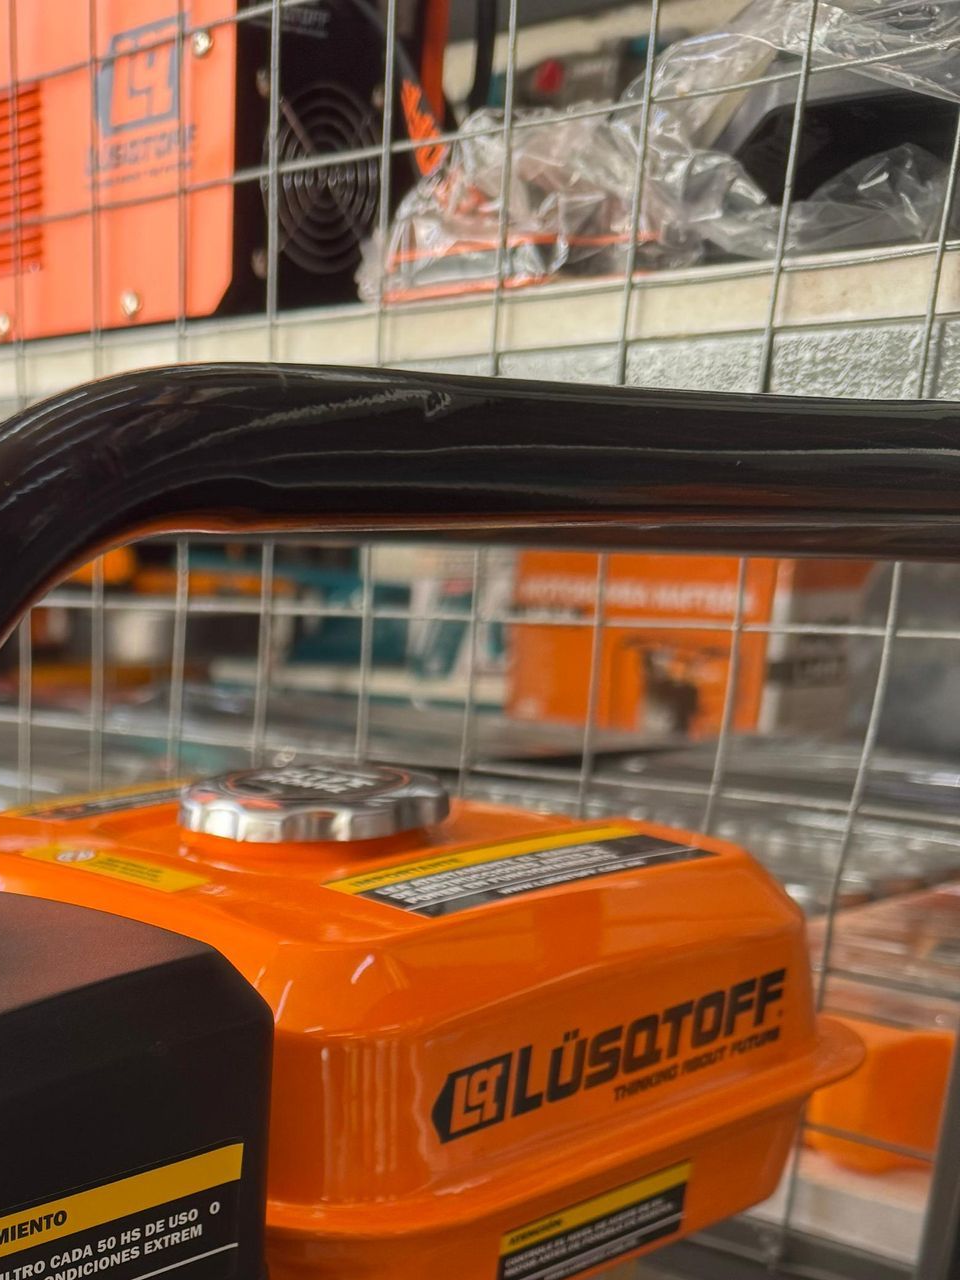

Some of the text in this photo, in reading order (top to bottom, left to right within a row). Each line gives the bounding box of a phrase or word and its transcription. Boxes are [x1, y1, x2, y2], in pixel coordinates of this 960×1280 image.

[49, 1244, 93, 1269] CADA
[97, 1236, 117, 1253] 50
[120, 1227, 141, 1246] HS
[145, 1219, 166, 1237] DE
[168, 1208, 199, 1228] USO
[209, 1201, 221, 1215] O
[144, 1223, 203, 1255] EXTREM
